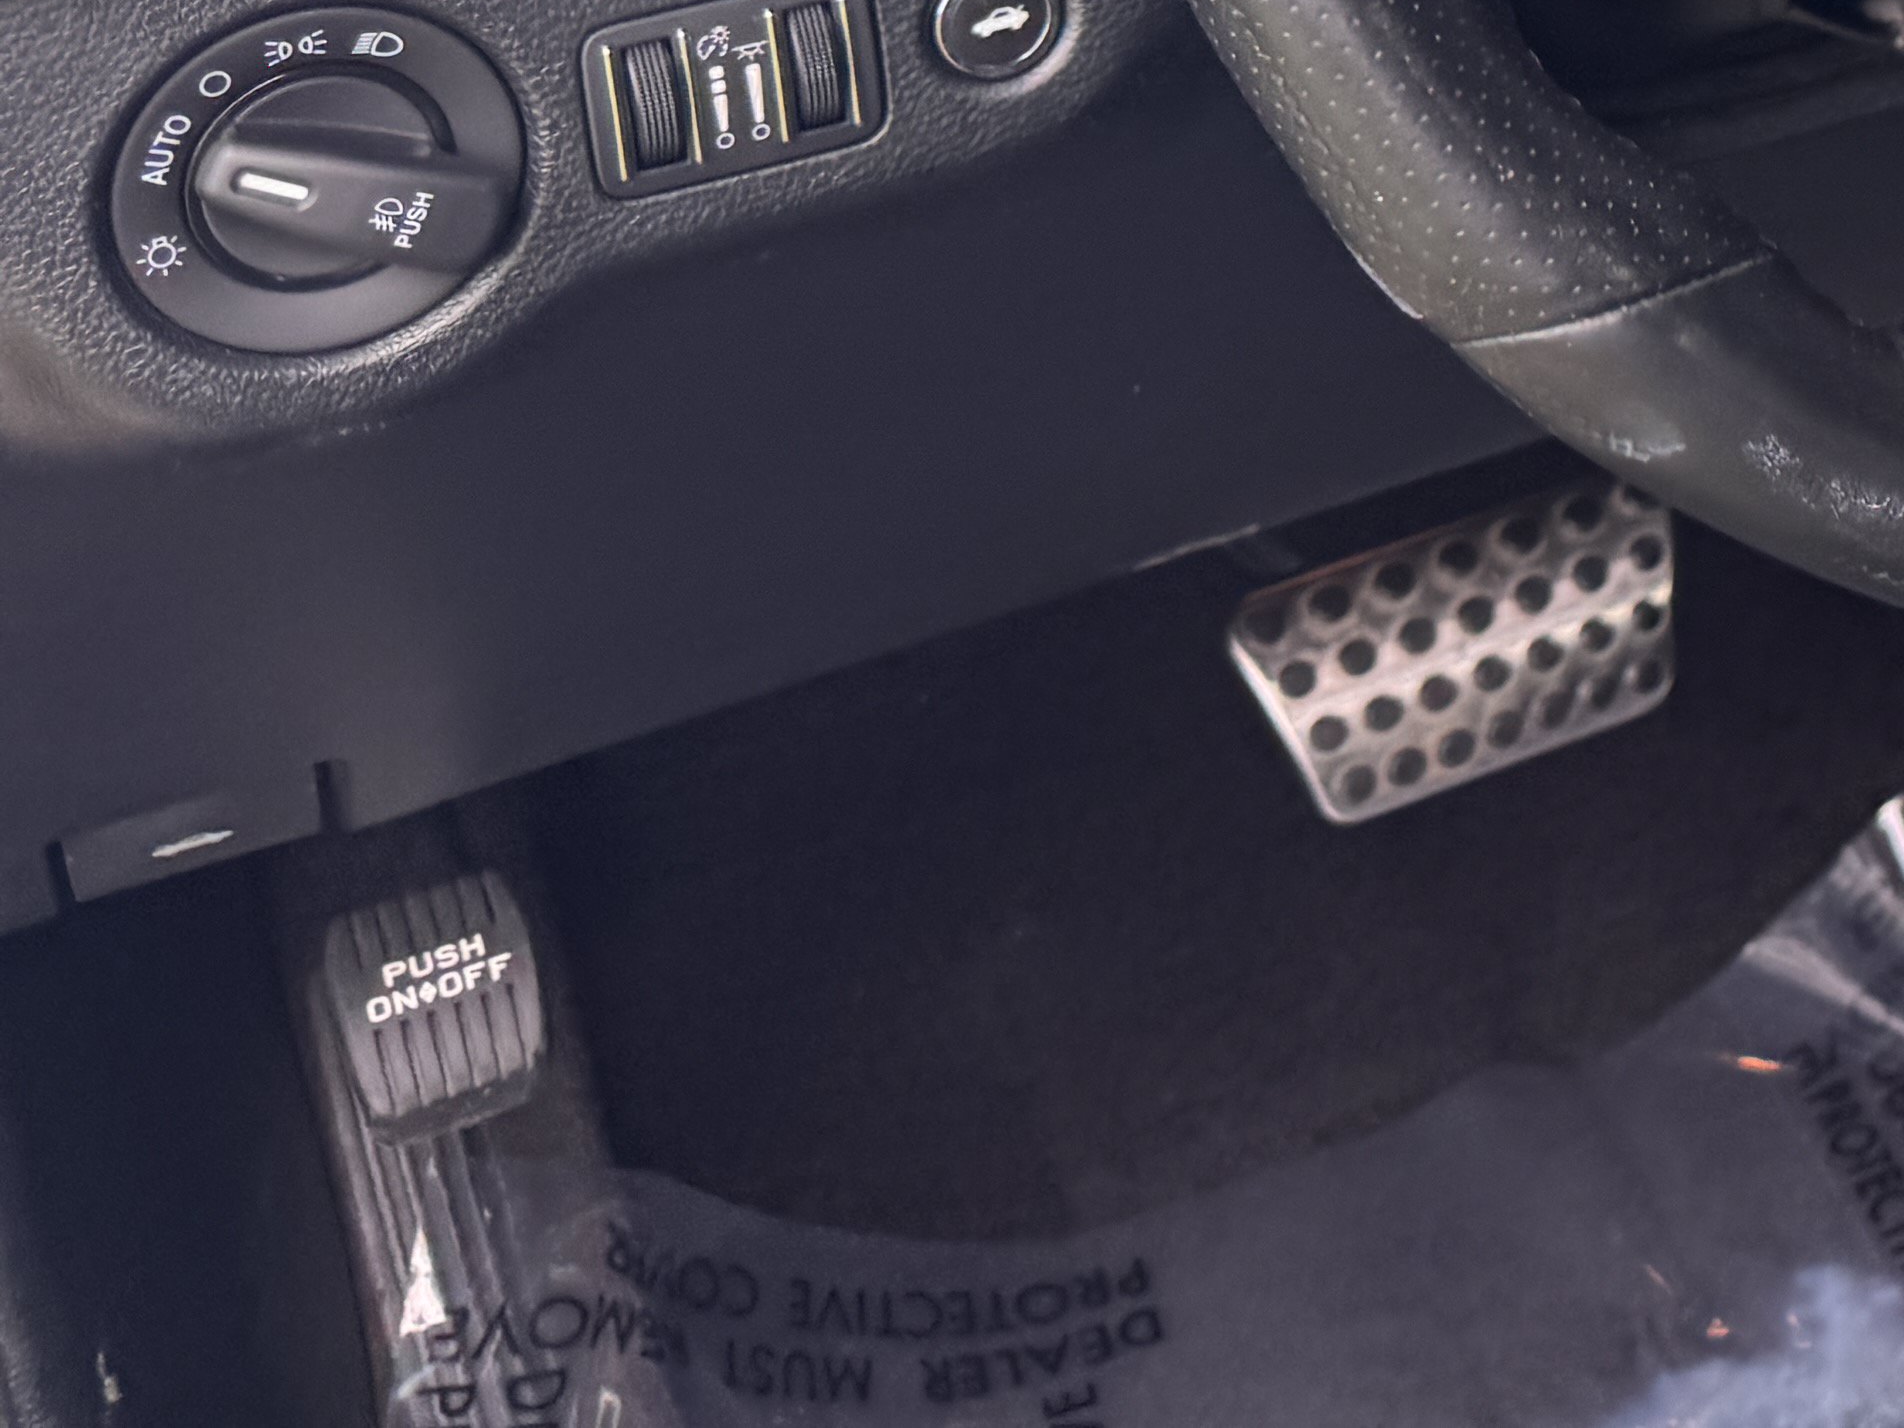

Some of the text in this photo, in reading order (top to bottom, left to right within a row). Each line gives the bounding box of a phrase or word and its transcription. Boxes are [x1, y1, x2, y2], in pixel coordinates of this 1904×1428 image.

[141, 114, 192, 186] AUTO
[393, 191, 434, 249] PUSH
[380, 932, 487, 988] PUSH
[790, 1256, 1151, 1339] PROTECTIVE
[723, 1341, 875, 1403] MUST
[920, 1306, 1164, 1404] DEALER
